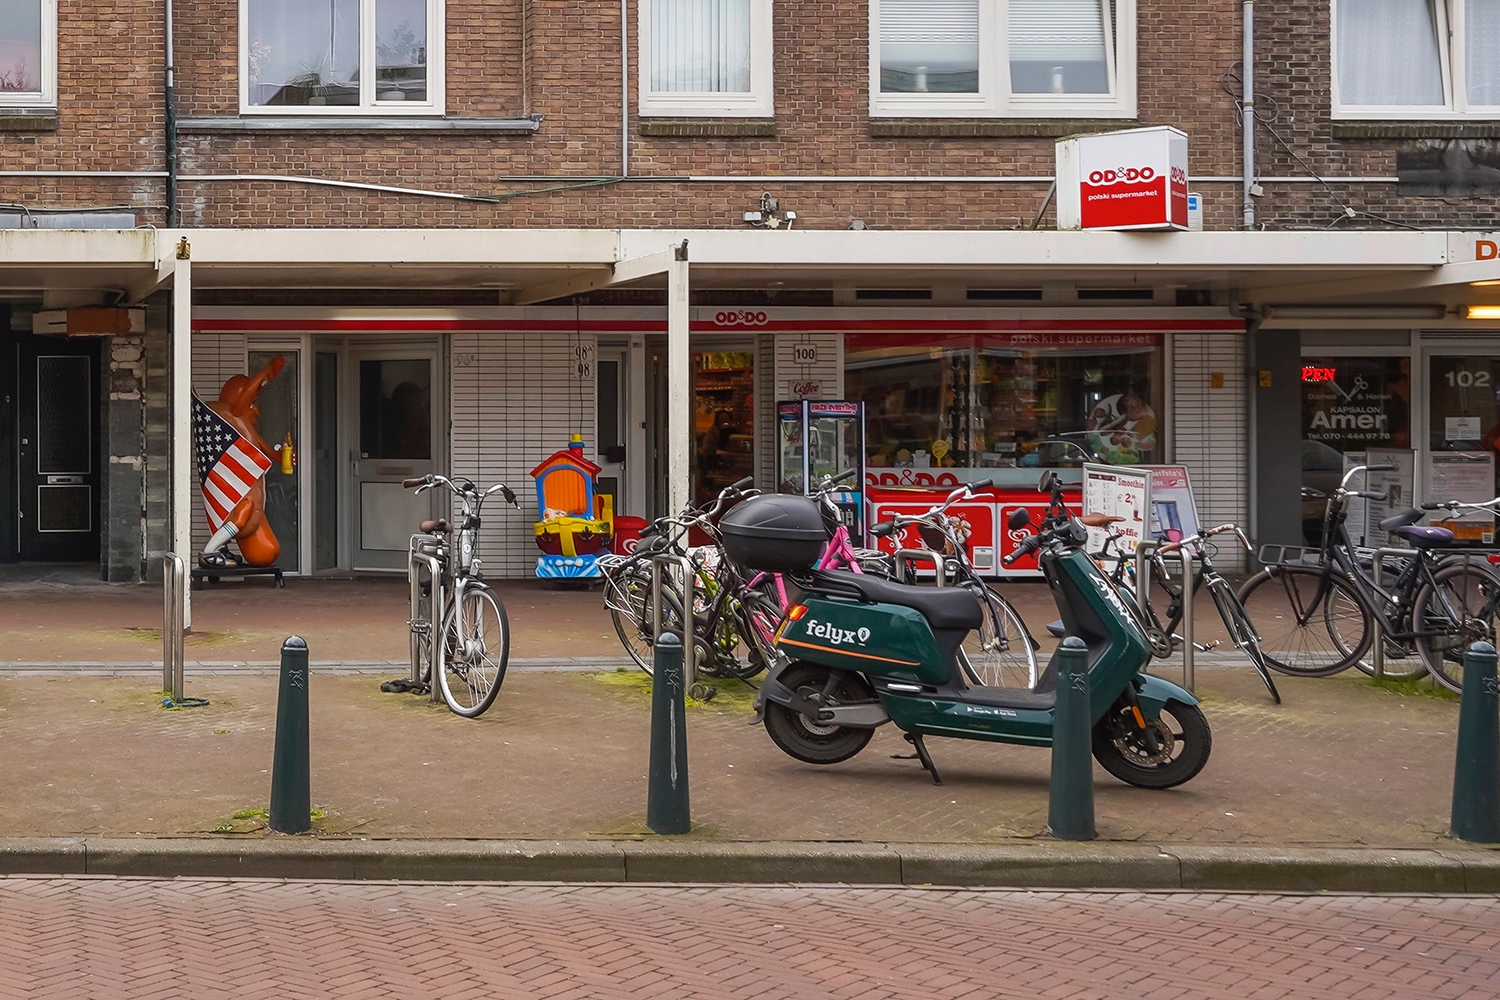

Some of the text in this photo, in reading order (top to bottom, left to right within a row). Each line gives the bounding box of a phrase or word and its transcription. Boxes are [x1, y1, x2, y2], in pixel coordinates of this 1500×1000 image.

[1089, 166, 1155, 184] OD&DO
[1088, 189, 1158, 202] polski supermarket
[715, 309, 768, 324] OD&DO
[1010, 334, 1151, 346] polski supermarket
[795, 348, 815, 360] 100
[577, 363, 590, 378] 98
[1445, 371, 1490, 388] 102
[793, 381, 820, 396] Coffee
[1330, 406, 1381, 414] KAPSALON
[1310, 410, 1388, 429] Amer
[1323, 432, 1341, 440] 070
[1117, 478, 1145, 489] Smoothie
[1115, 526, 1139, 538] koffie
[805, 619, 856, 645] felyx
